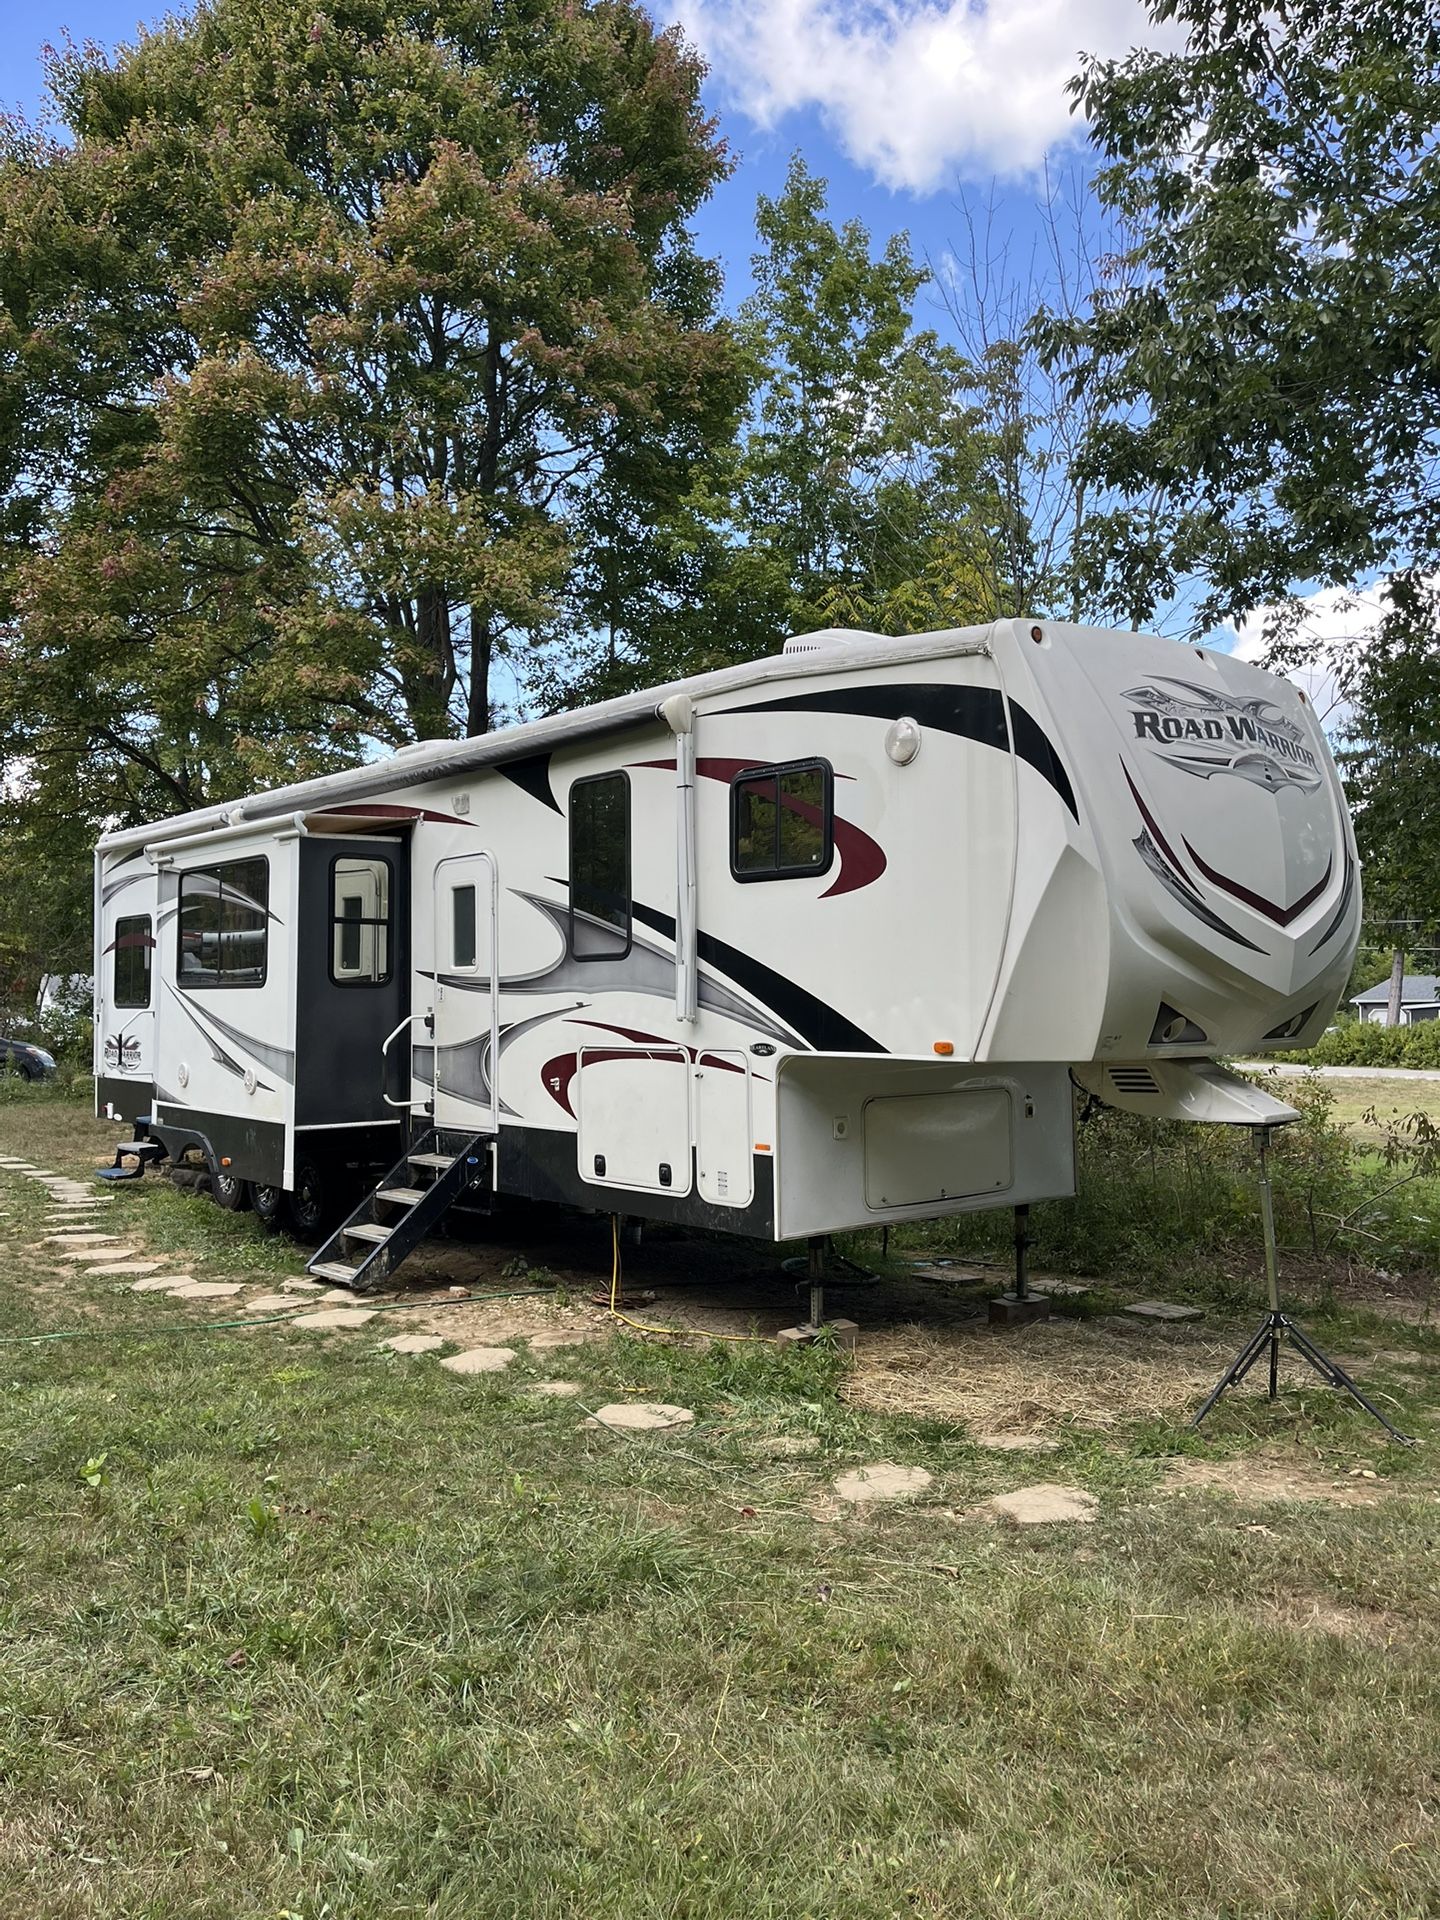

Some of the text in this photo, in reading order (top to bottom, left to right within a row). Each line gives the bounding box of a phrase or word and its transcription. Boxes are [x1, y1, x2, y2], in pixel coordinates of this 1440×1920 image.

[1131, 711, 1321, 774] ROAD WARRIOR
[104, 1047, 142, 1061] ROAD ARRIOR
